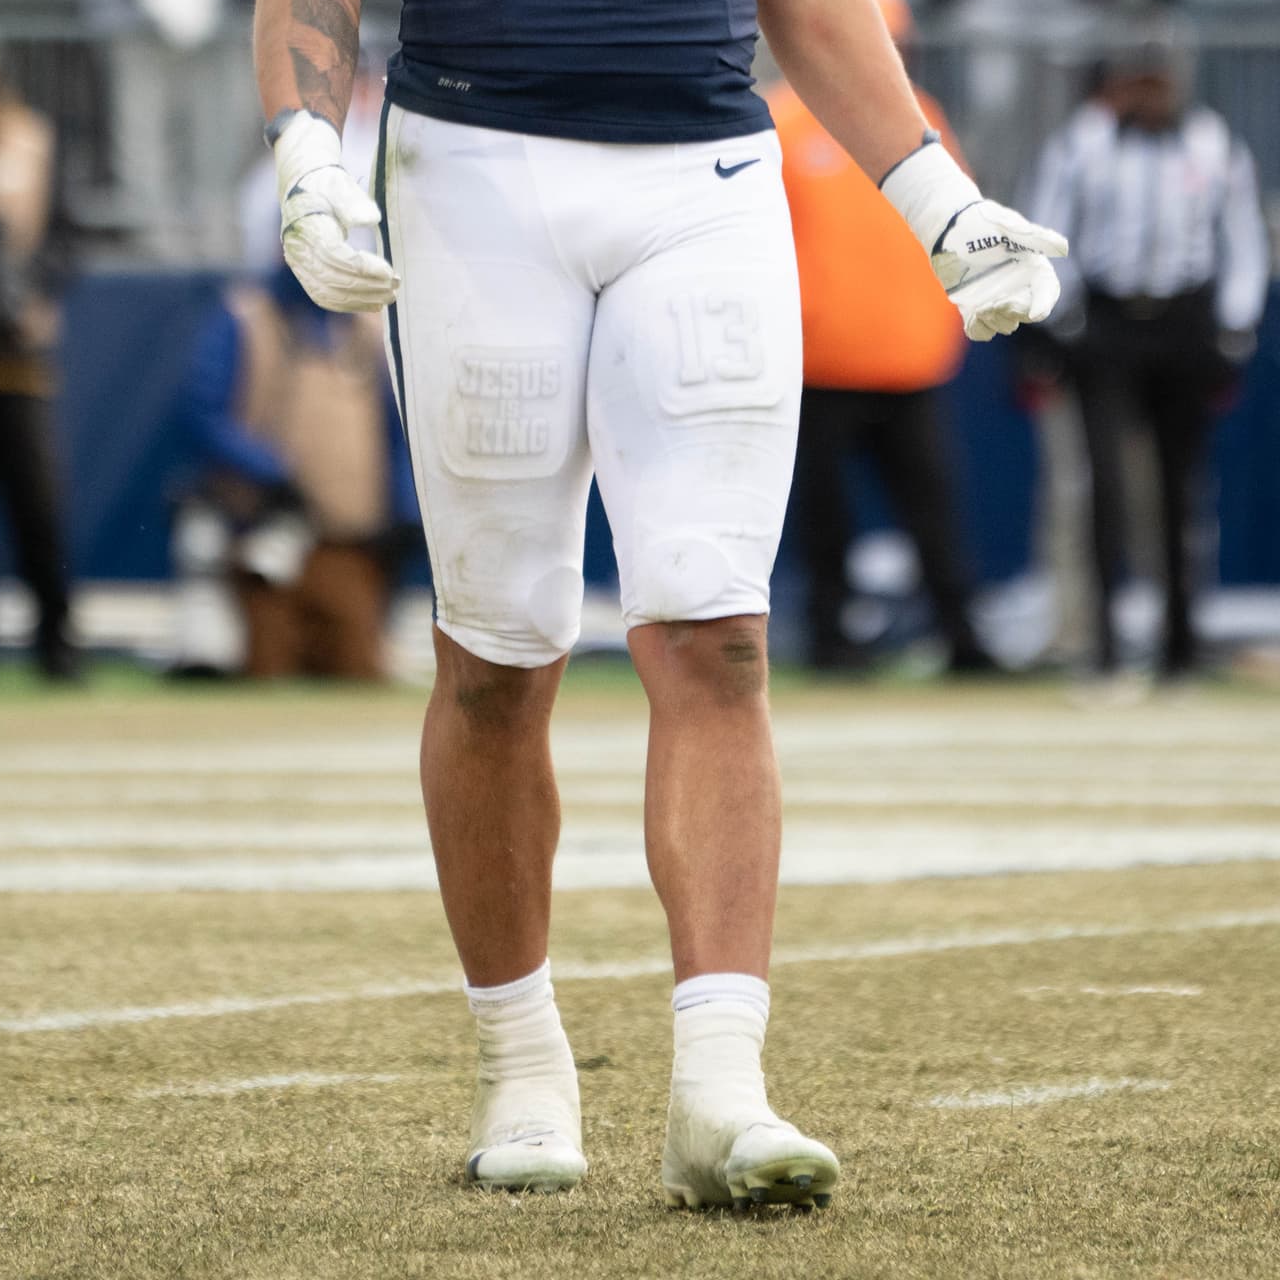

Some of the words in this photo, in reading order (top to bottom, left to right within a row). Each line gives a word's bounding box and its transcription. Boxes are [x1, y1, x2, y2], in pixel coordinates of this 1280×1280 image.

[966, 235, 1011, 254] STATE
[667, 294, 766, 386] 13
[457, 361, 560, 400] JESUS
[498, 399, 520, 419] IS
[465, 418, 549, 457] KING
